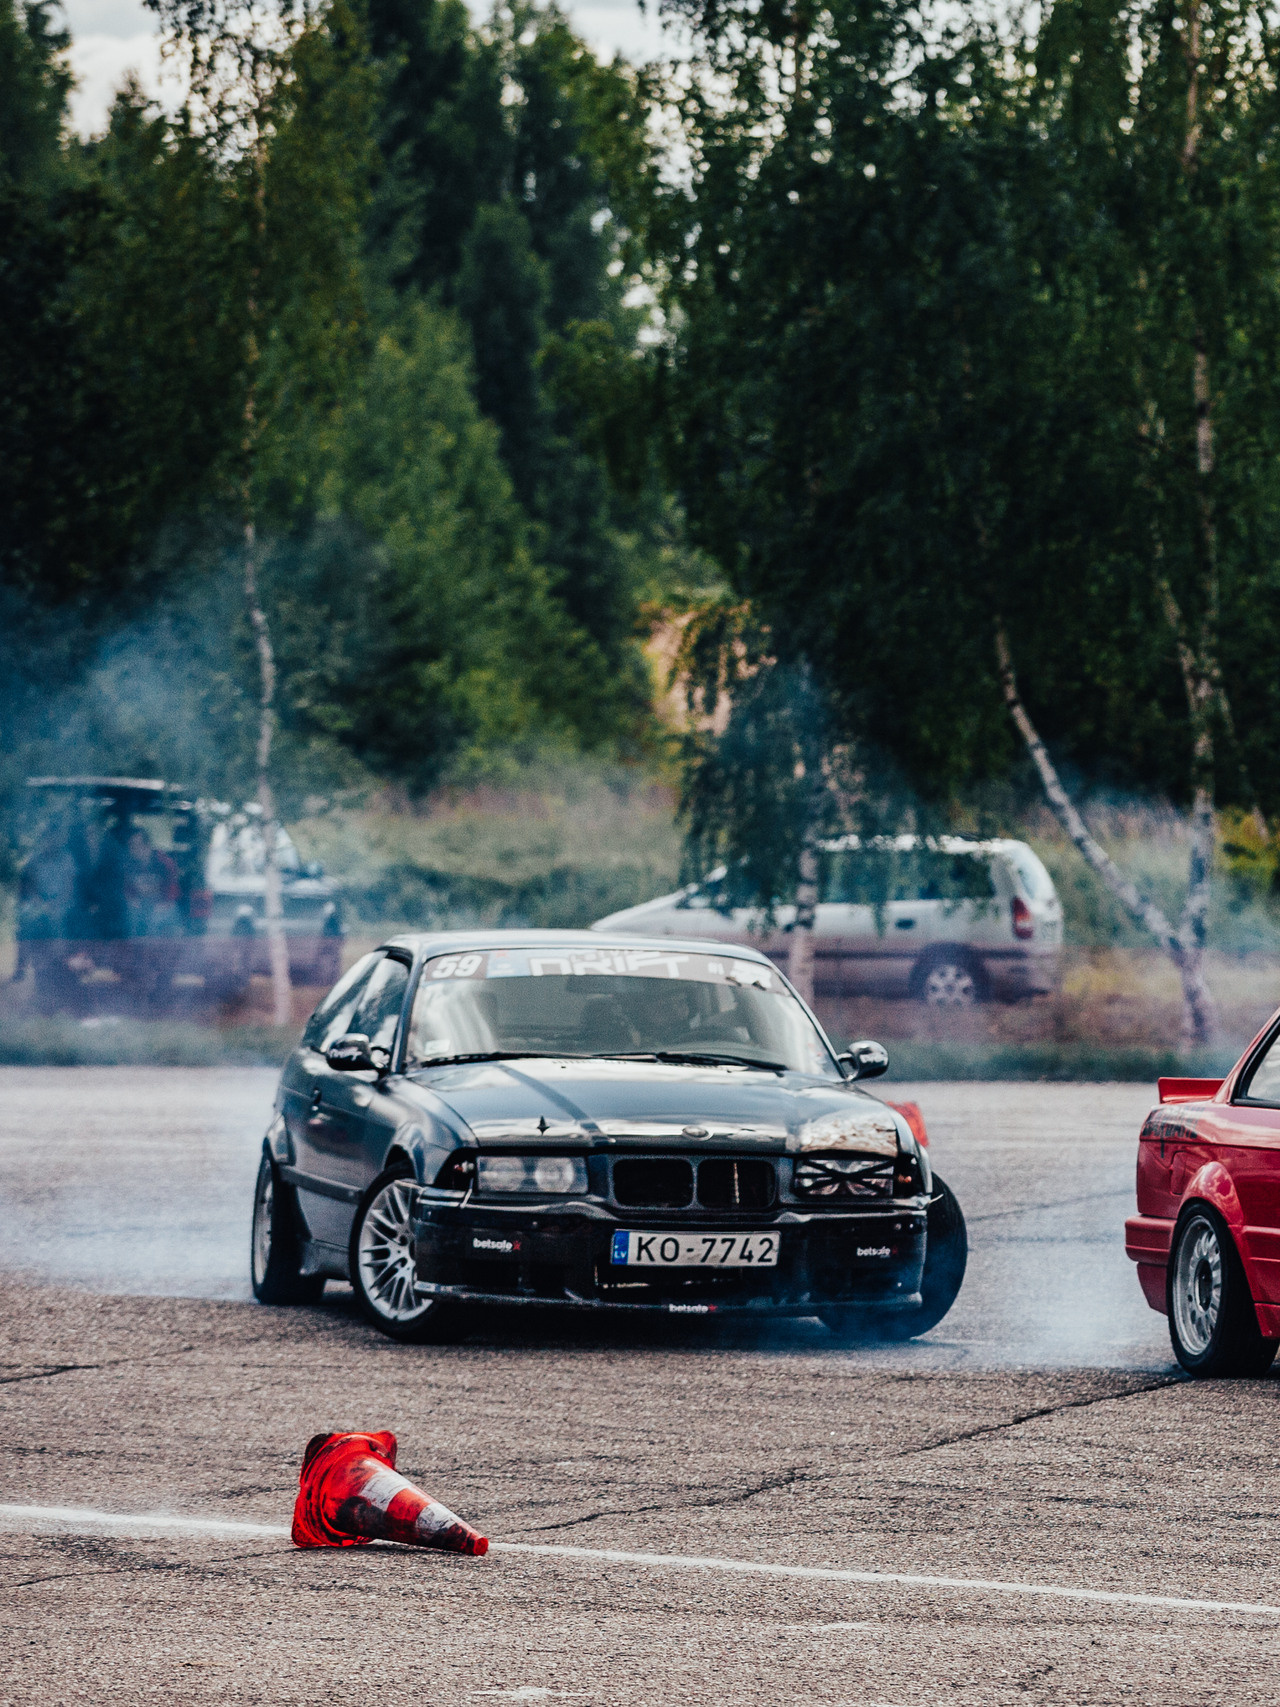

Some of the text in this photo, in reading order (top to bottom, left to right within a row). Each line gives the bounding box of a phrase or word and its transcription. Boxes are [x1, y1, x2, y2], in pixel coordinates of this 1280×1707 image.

[431, 955, 483, 979] 59
[529, 951, 690, 978] DRIFT
[614, 1251, 627, 1259] LV
[636, 1236, 774, 1263] KO-7742
